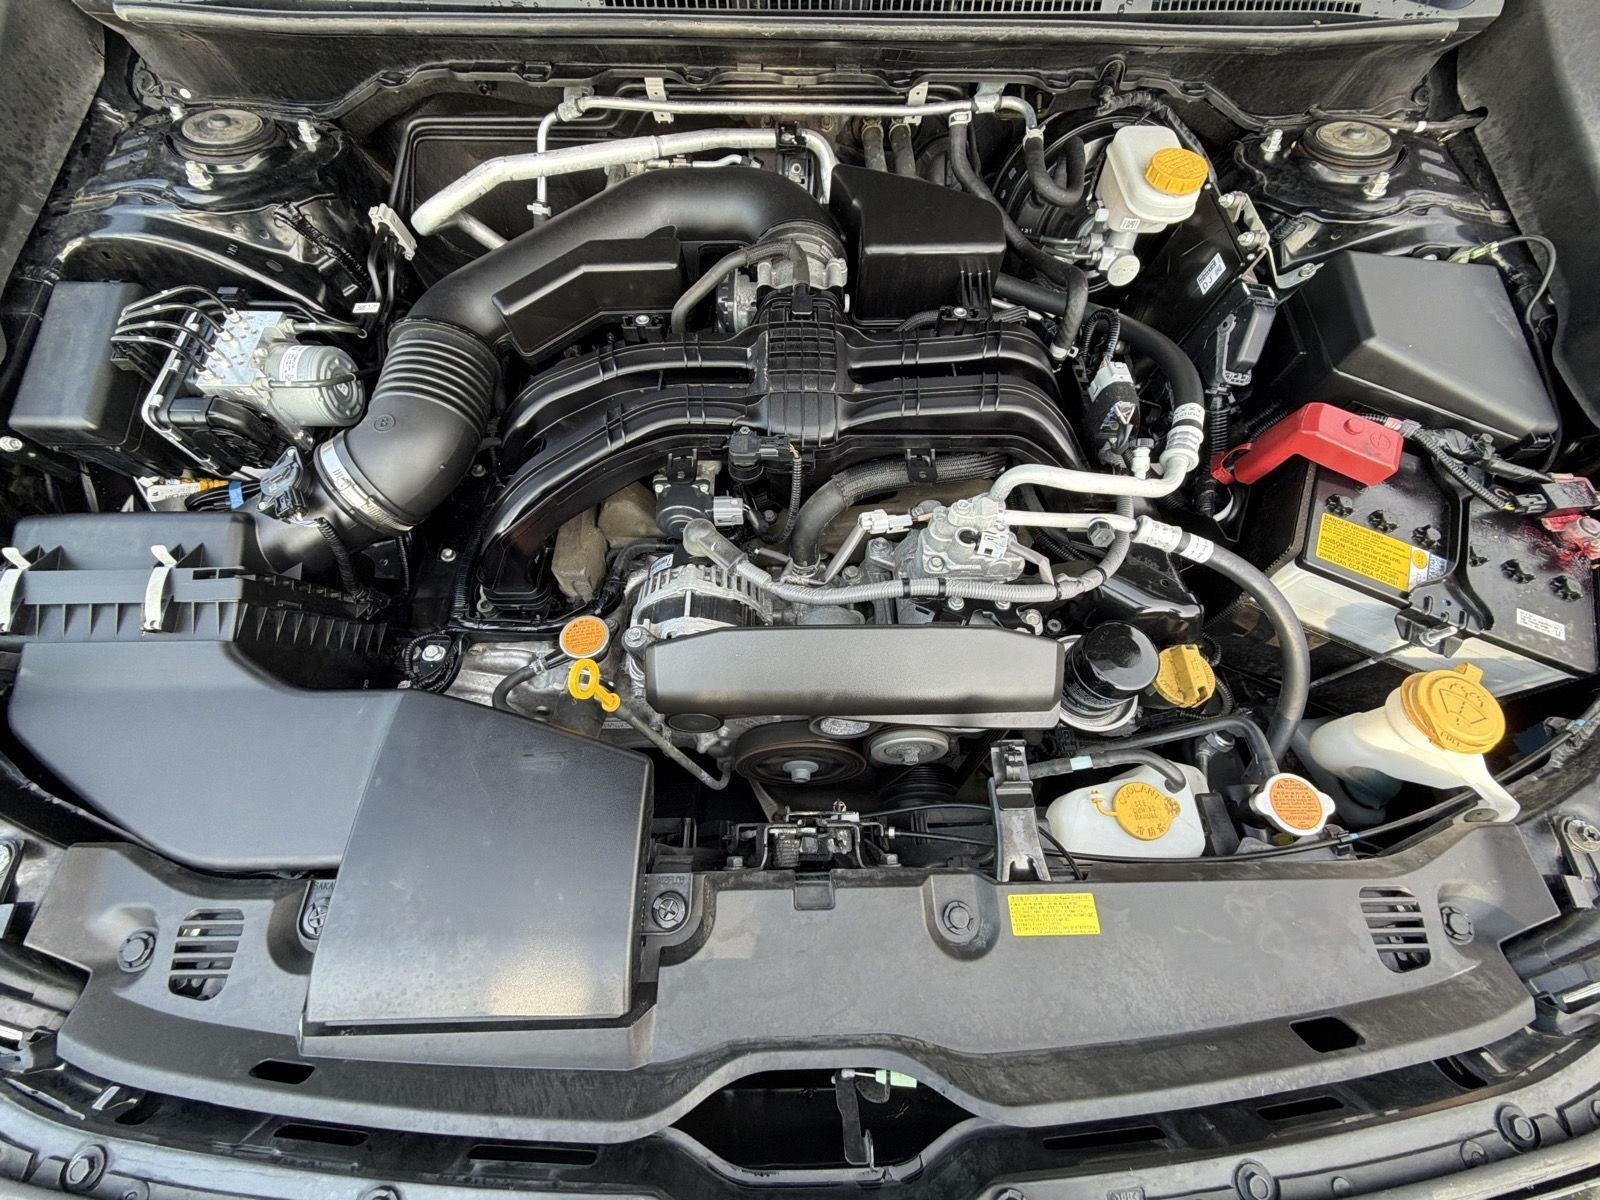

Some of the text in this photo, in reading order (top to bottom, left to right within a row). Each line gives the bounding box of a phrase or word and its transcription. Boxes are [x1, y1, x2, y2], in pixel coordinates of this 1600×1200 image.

[1324, 514, 1349, 527] DANGER
[1321, 535, 1345, 548] POISON
[1118, 785, 1160, 805] COOLANT
